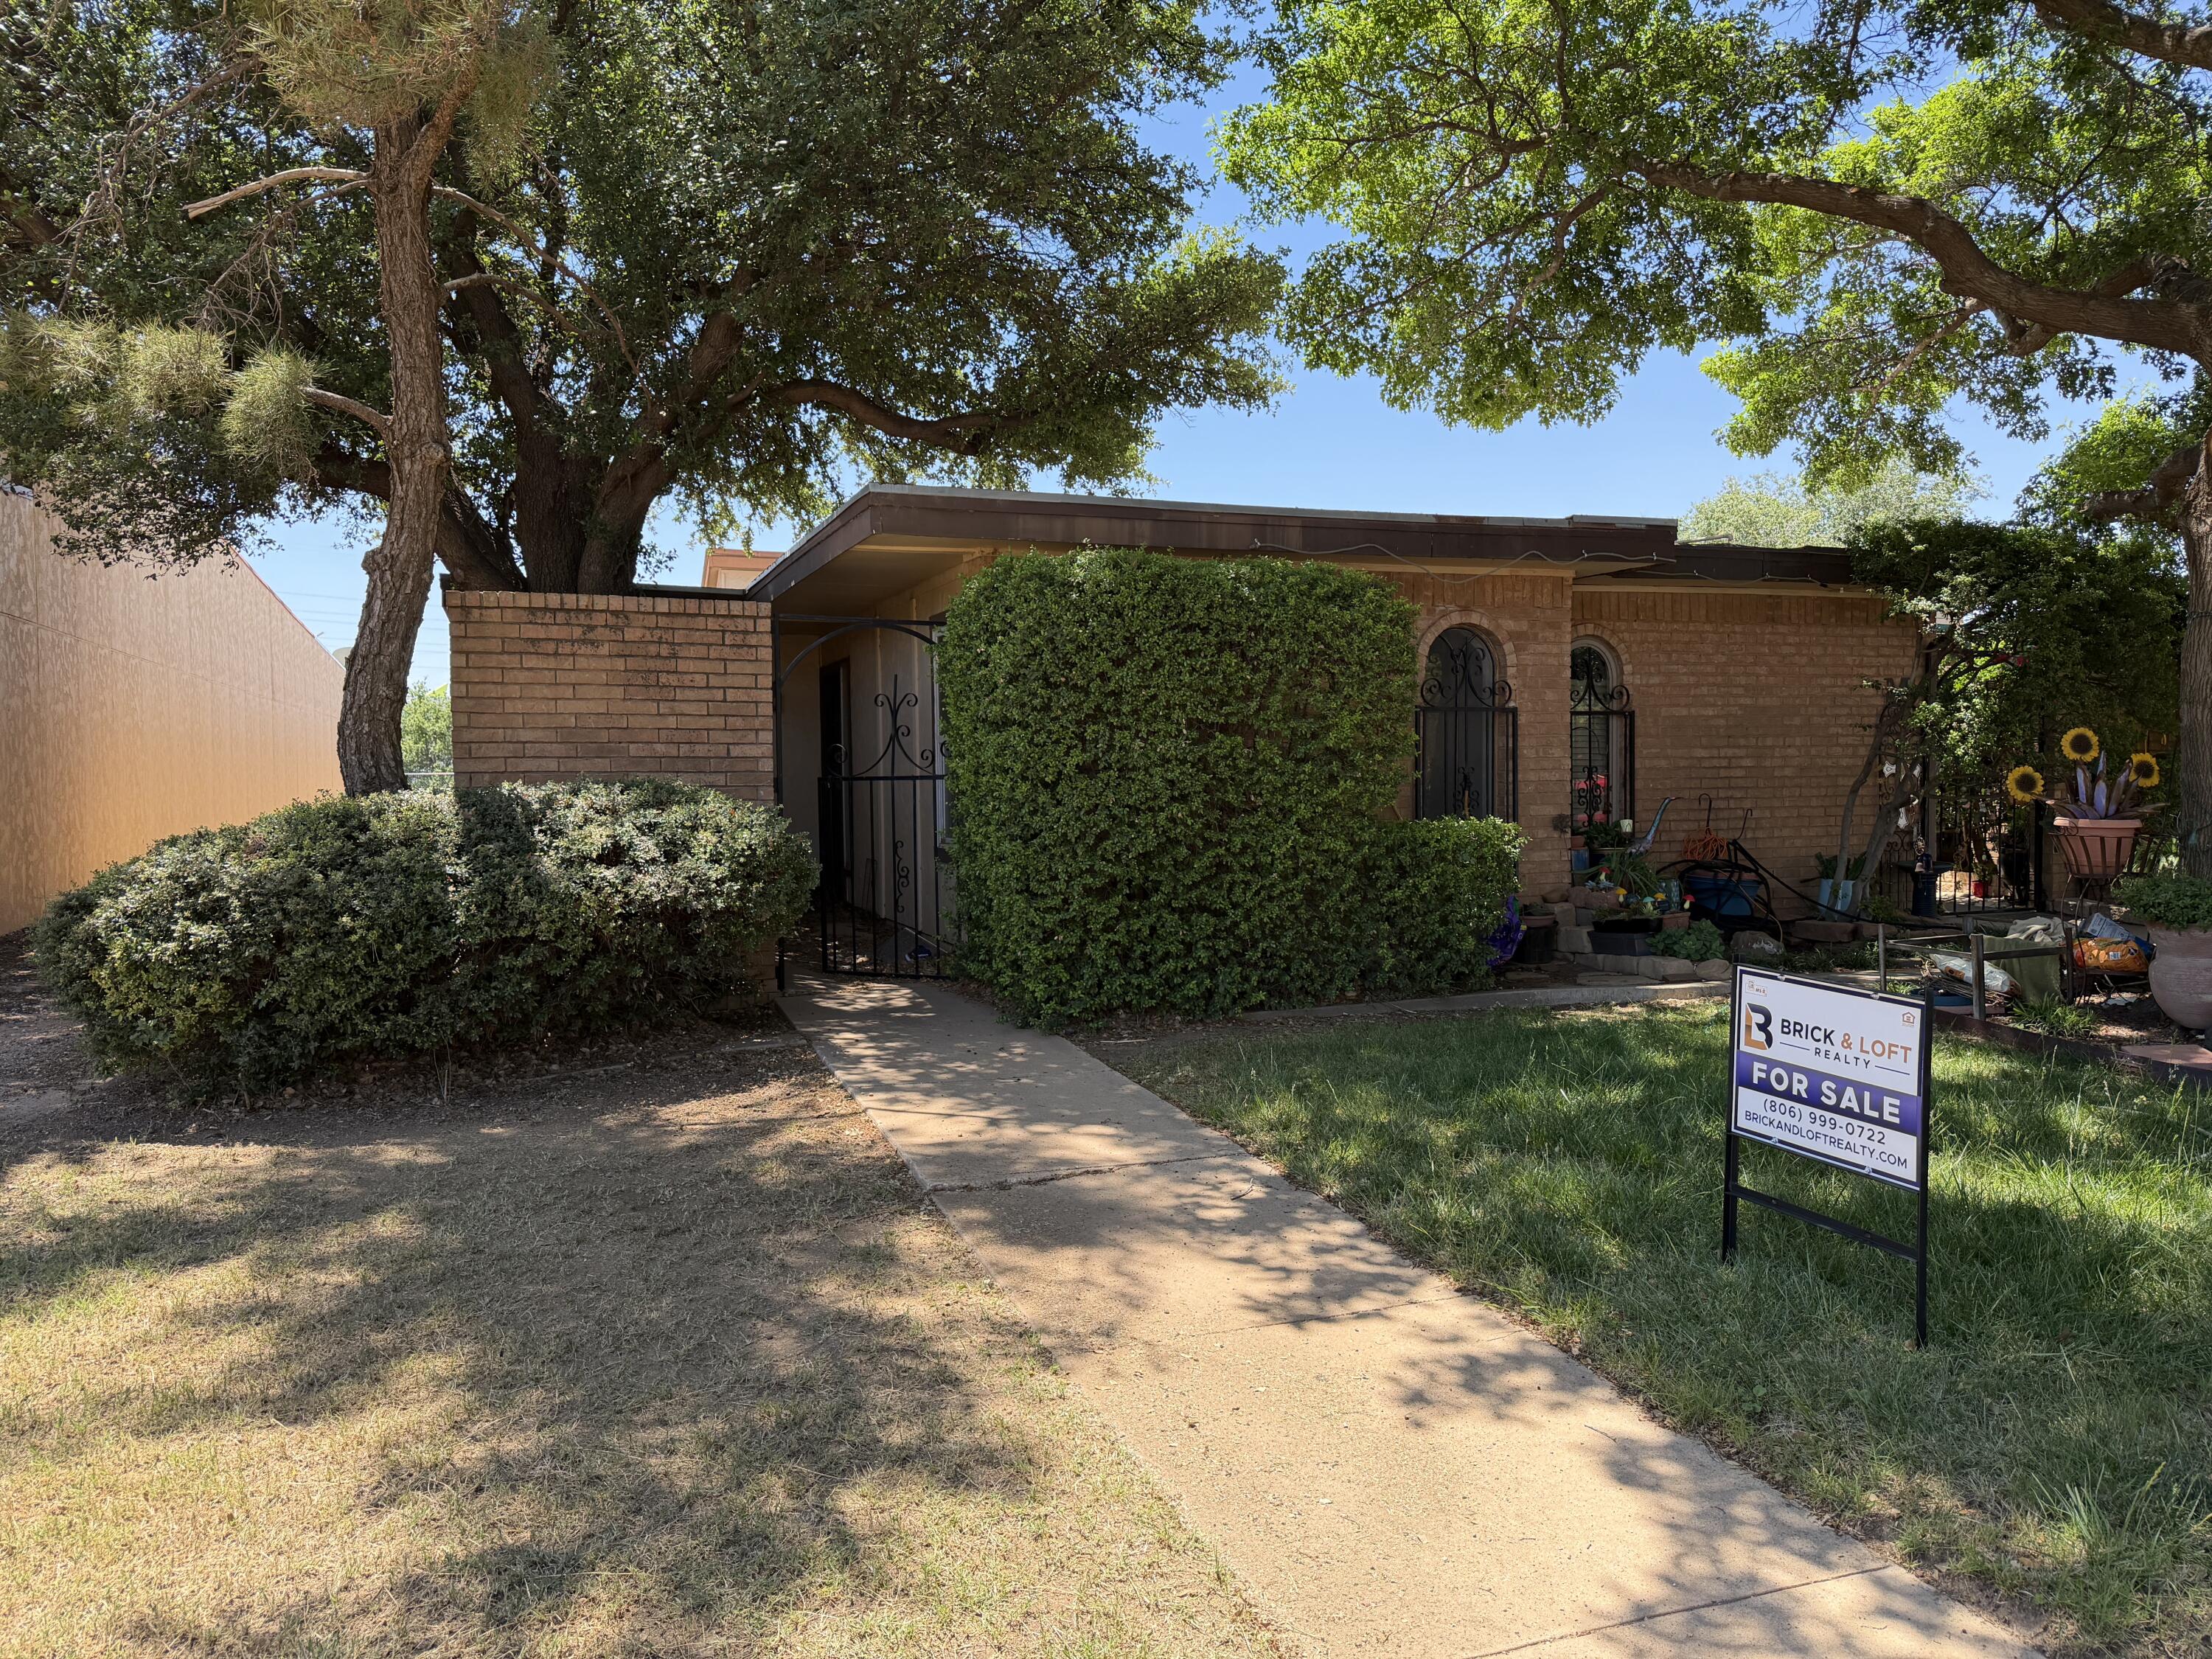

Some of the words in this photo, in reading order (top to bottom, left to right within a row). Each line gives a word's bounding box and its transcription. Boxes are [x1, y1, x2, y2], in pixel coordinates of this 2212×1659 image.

[1781, 1018, 1835, 1046] BRICK
[1840, 1032, 1853, 1051] &
[1859, 1036, 1912, 1063] LOFT
[1815, 1046, 1871, 1069] REALTY
[1753, 1061, 1809, 1099] FOR
[1820, 1079, 1900, 1124] SALE
[1745, 1110, 1908, 1169] BRICKANDLOFTREALTY.COM
[1763, 1098, 1803, 1122] (806)
[1809, 1111, 1886, 1145] 999-0722
